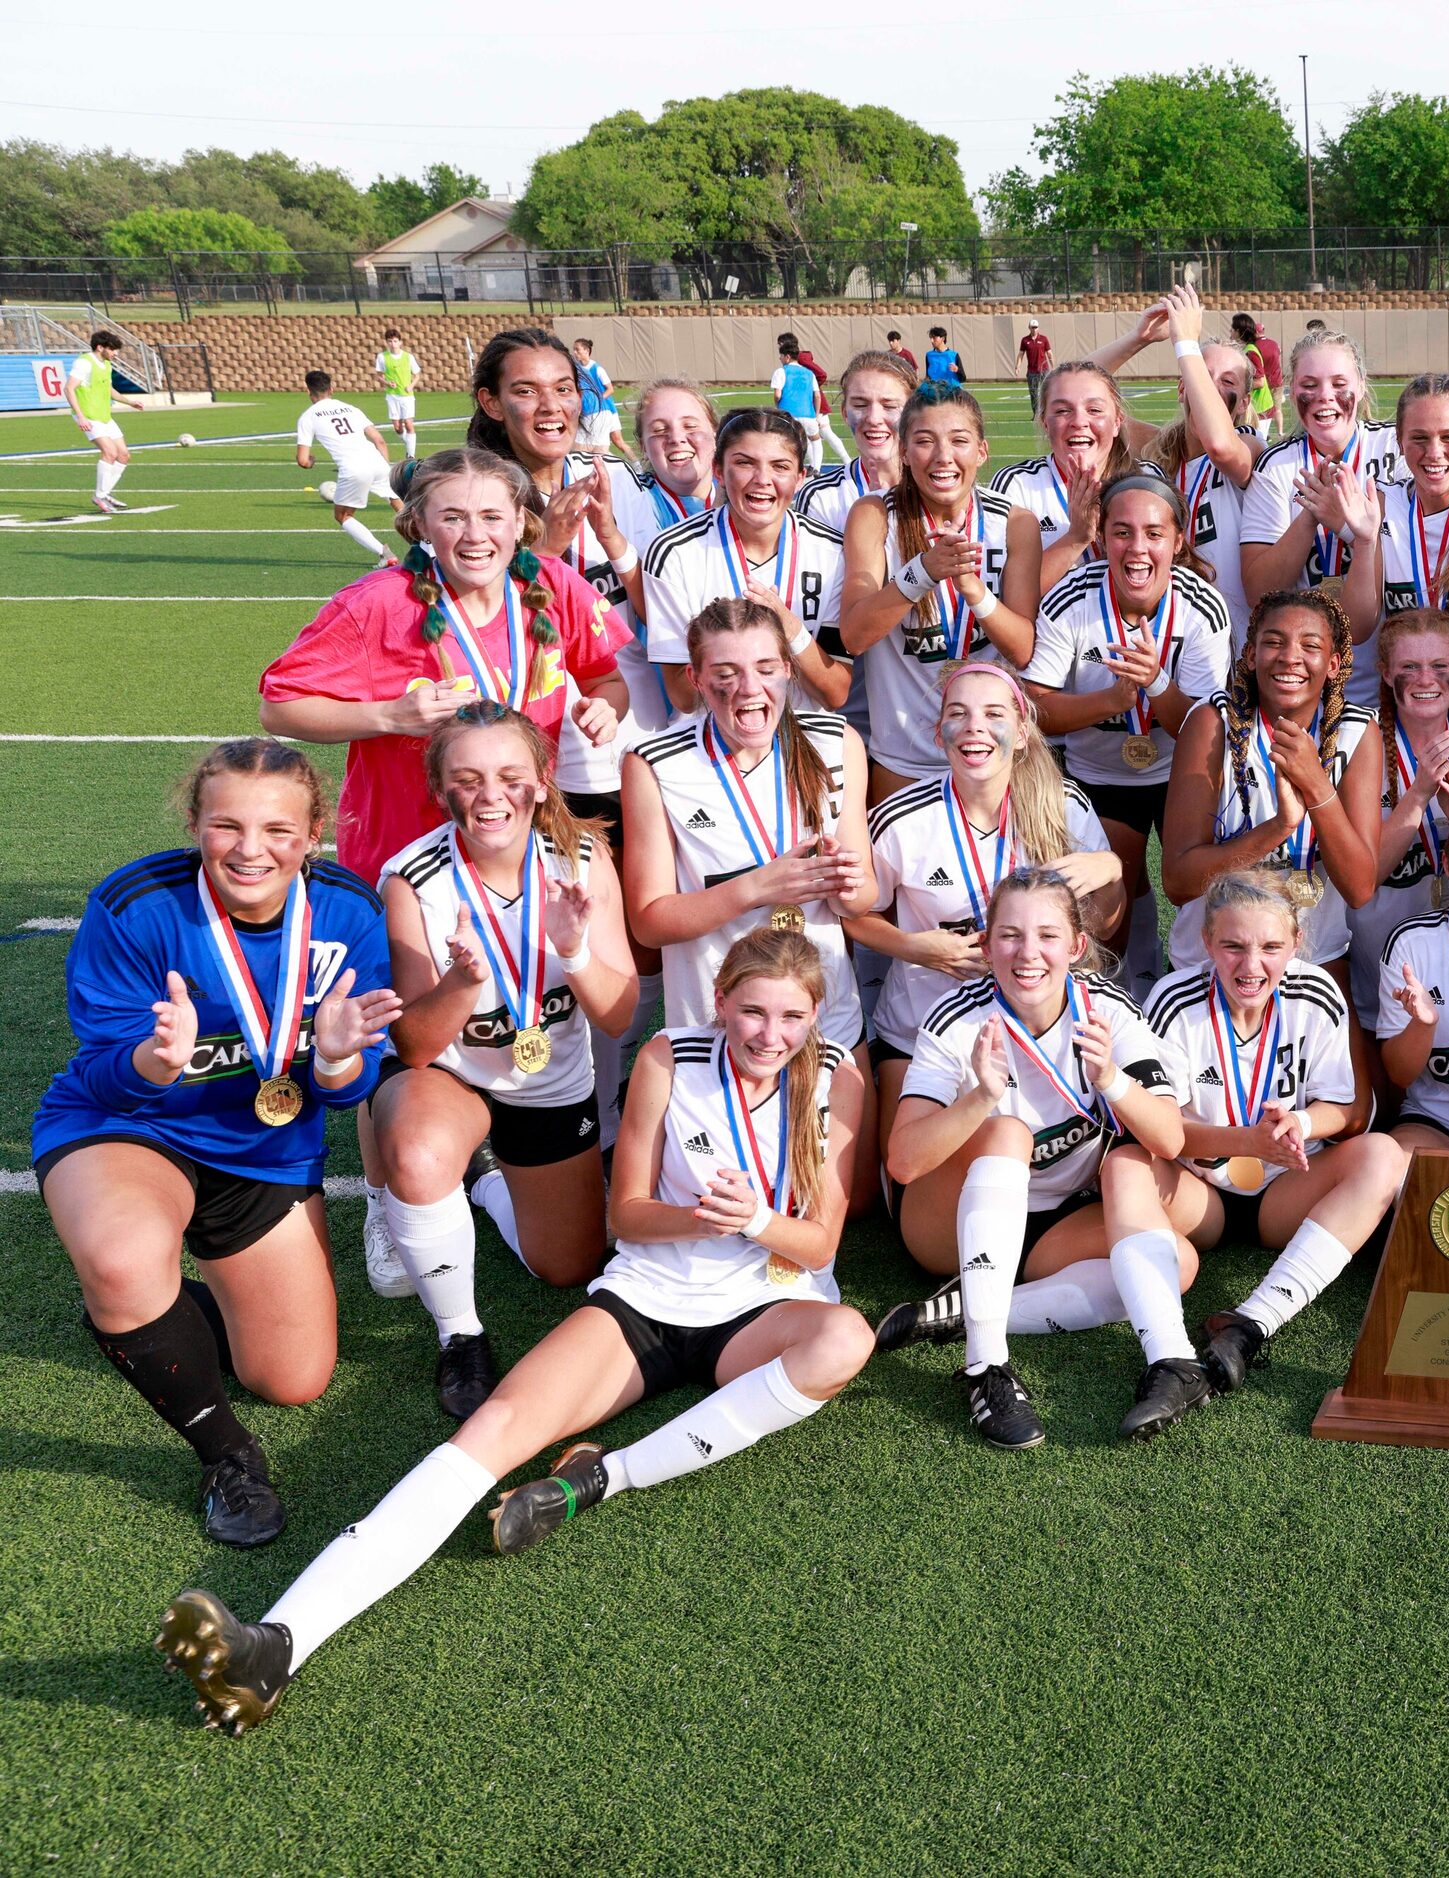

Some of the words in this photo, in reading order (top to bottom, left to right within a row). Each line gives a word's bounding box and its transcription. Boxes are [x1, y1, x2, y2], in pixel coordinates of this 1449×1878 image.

[41, 366, 62, 397] G
[331, 417, 354, 436] 21
[801, 571, 822, 621] 8
[685, 821, 717, 829] adidas
[1196, 1077, 1223, 1086] adidas
[684, 1142, 715, 1156] adidas
[963, 1264, 997, 1272] adidas
[1411, 1311, 1447, 1343] UNIVERSITY
[687, 1432, 709, 1459] adidas
